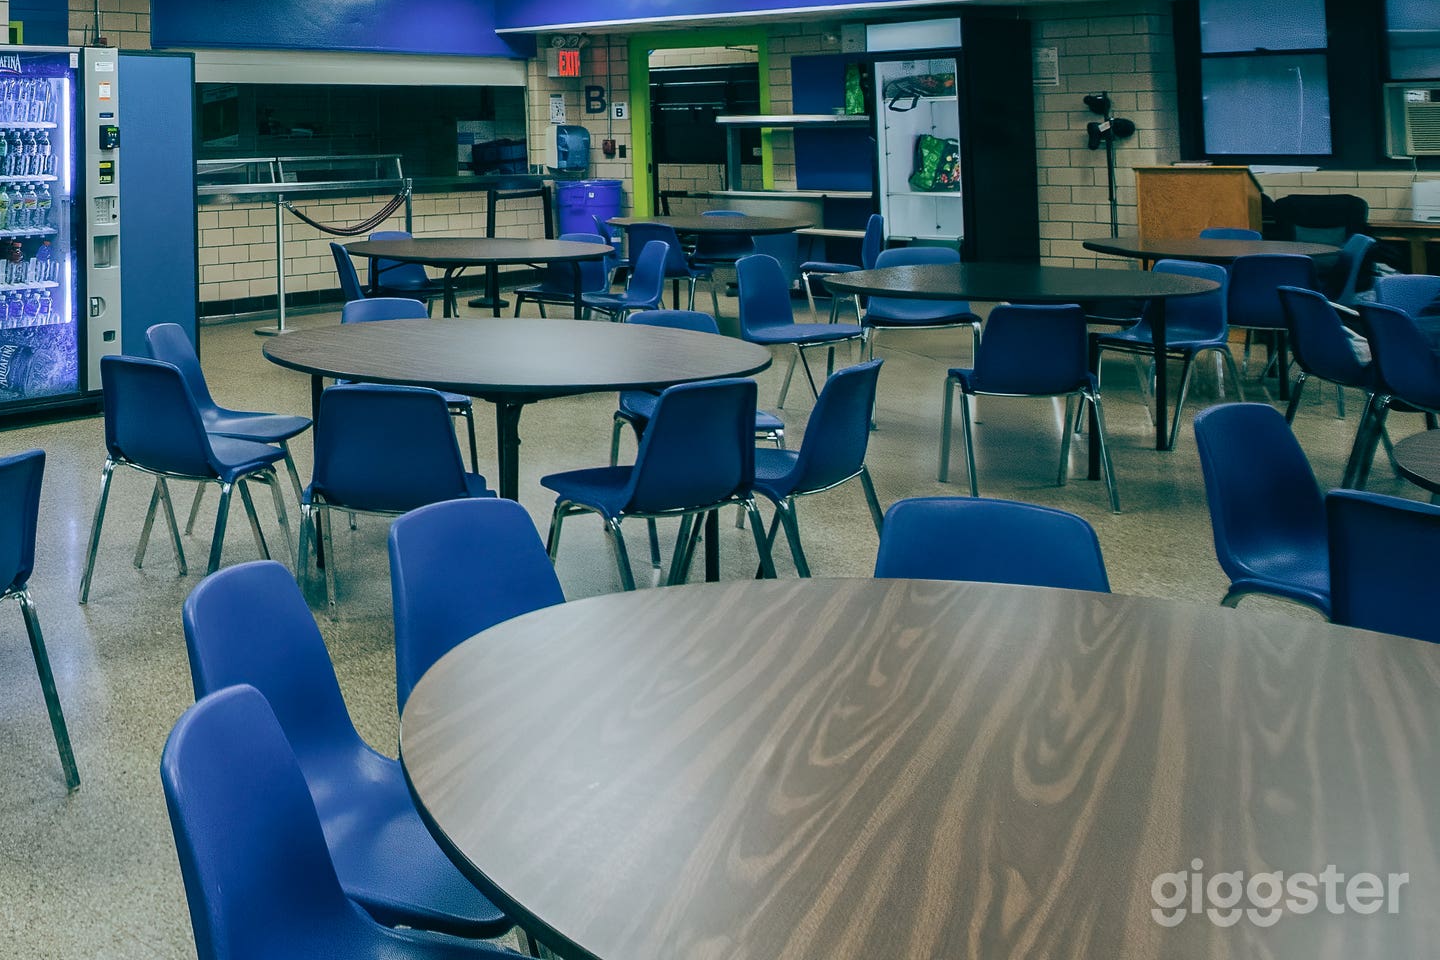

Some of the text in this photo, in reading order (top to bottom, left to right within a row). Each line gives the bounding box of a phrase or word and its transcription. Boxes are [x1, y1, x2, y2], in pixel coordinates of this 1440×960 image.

[559, 50, 580, 76] EXIT
[585, 85, 606, 114] B
[616, 108, 623, 117] B
